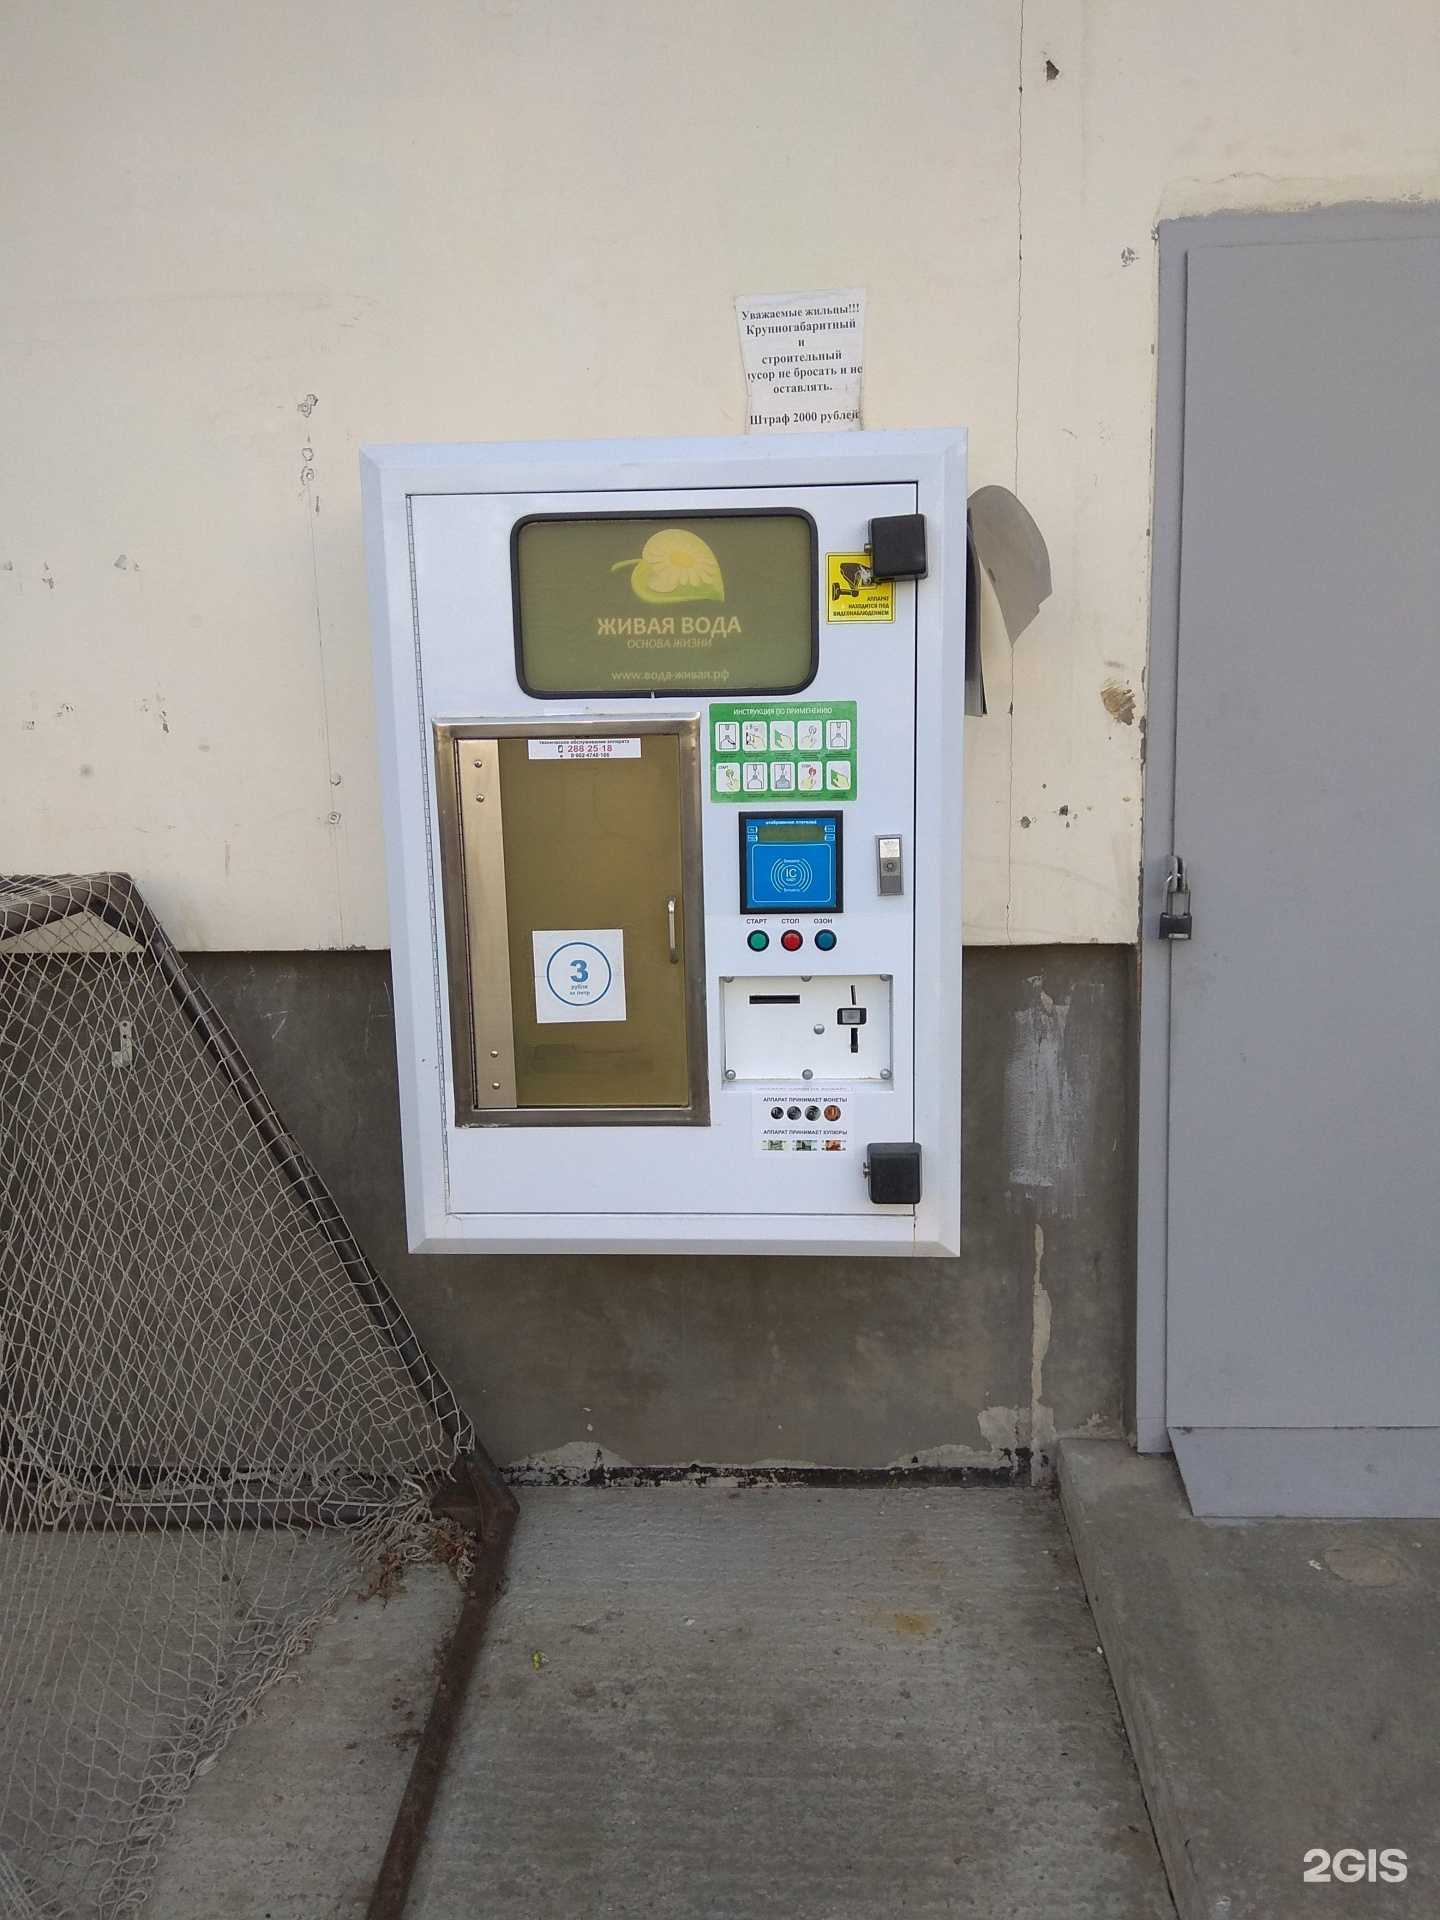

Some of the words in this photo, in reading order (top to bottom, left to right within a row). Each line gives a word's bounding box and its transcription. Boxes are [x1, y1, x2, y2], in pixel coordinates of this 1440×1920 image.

[741, 309, 803, 320] Уважаемые
[805, 303, 860, 316] жильцы!!!
[746, 319, 856, 337] Крупногабаритный
[798, 339, 805, 347] и
[761, 350, 842, 366] строительный
[778, 371, 791, 379] не
[793, 367, 837, 380] бросать
[840, 367, 847, 375] и
[850, 365, 863, 374] не
[773, 383, 833, 394] оставлять.
[750, 413, 790, 426] Штраф
[793, 412, 817, 423] 2000
[820, 409, 860, 424] рублей
[597, 617, 675, 636] ЖИВАЯ
[681, 616, 742, 638] ВОДА
[626, 639, 670, 649] ОСНОВА
[673, 638, 713, 648] ЖИЗНИ
[734, 707, 774, 716] ИНСТРУКЦИЯ
[776, 707, 785, 715] ПО
[787, 706, 832, 715] ПРИМЕНЕНИЮ
[785, 868, 798, 878] IC
[570, 959, 589, 983] 3
